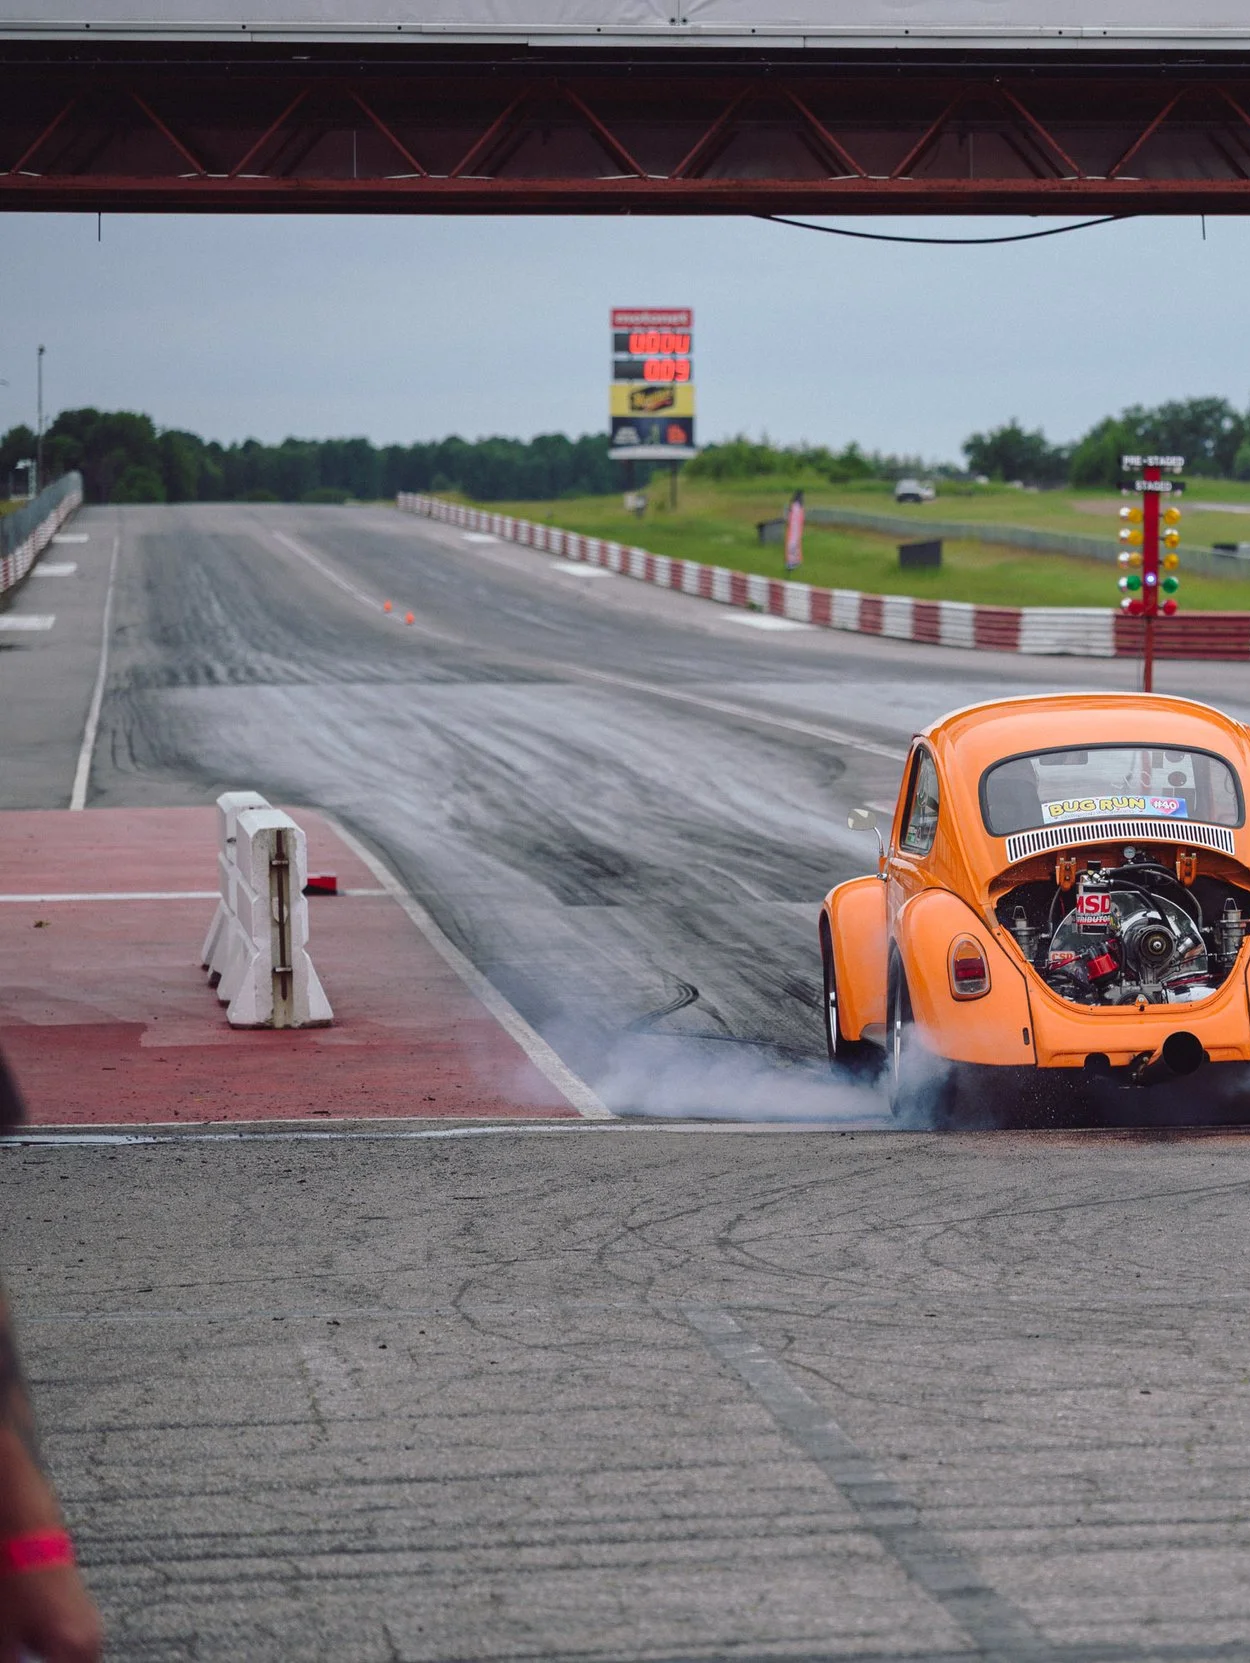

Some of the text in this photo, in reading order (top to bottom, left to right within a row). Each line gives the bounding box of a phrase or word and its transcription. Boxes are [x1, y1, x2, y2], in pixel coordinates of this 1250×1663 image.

[1134, 480, 1172, 492] STAGED
[1049, 799, 1097, 818] BUG
[1099, 796, 1146, 813] RUN
[1152, 799, 1178, 811] #40
